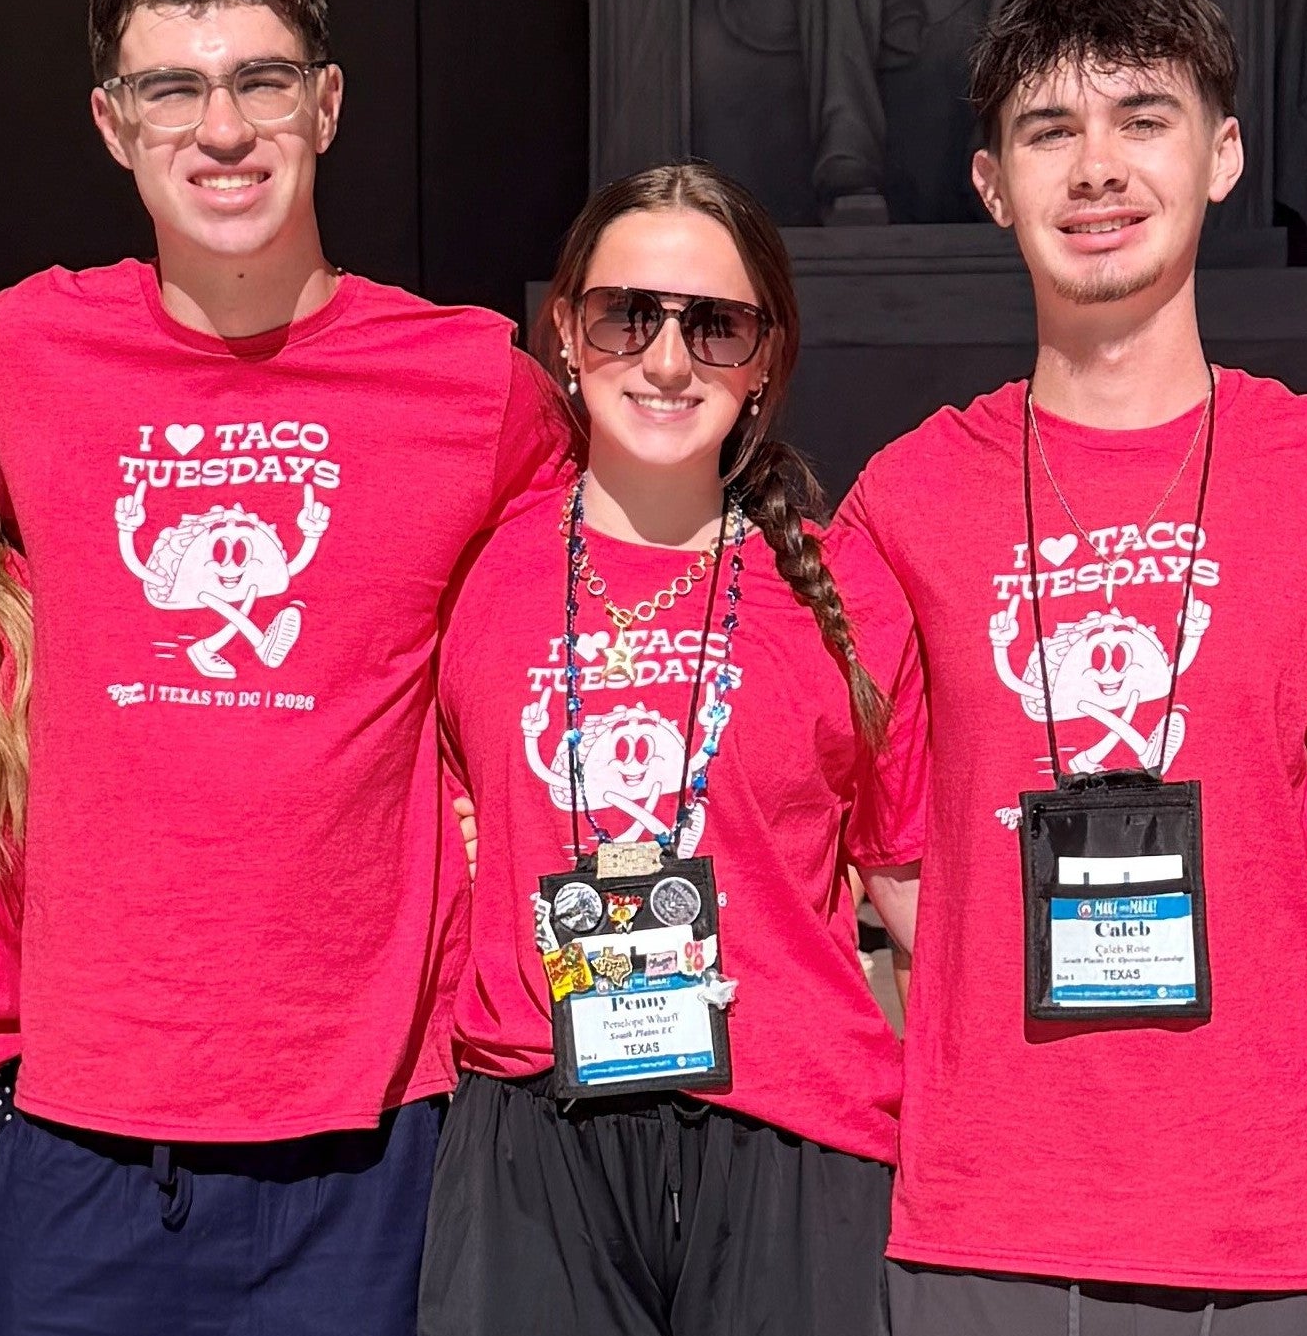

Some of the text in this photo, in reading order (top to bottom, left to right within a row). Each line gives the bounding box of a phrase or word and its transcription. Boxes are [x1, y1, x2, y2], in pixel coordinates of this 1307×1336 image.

[139, 421, 329, 452] I TACO
[119, 456, 340, 489] TUESDAYS
[1013, 522, 1206, 568] I TACO
[994, 557, 1220, 600] TUESDAYS
[549, 638, 563, 662] I
[158, 685, 212, 706] TEXAS
[215, 690, 235, 707] TO
[238, 691, 261, 707] DC
[274, 693, 316, 711] 2026
[1095, 921, 1151, 937] Caleb
[1102, 969, 1141, 981] TEXAS
[611, 996, 668, 1011] Penny
[624, 1042, 660, 1056] TEXAS
